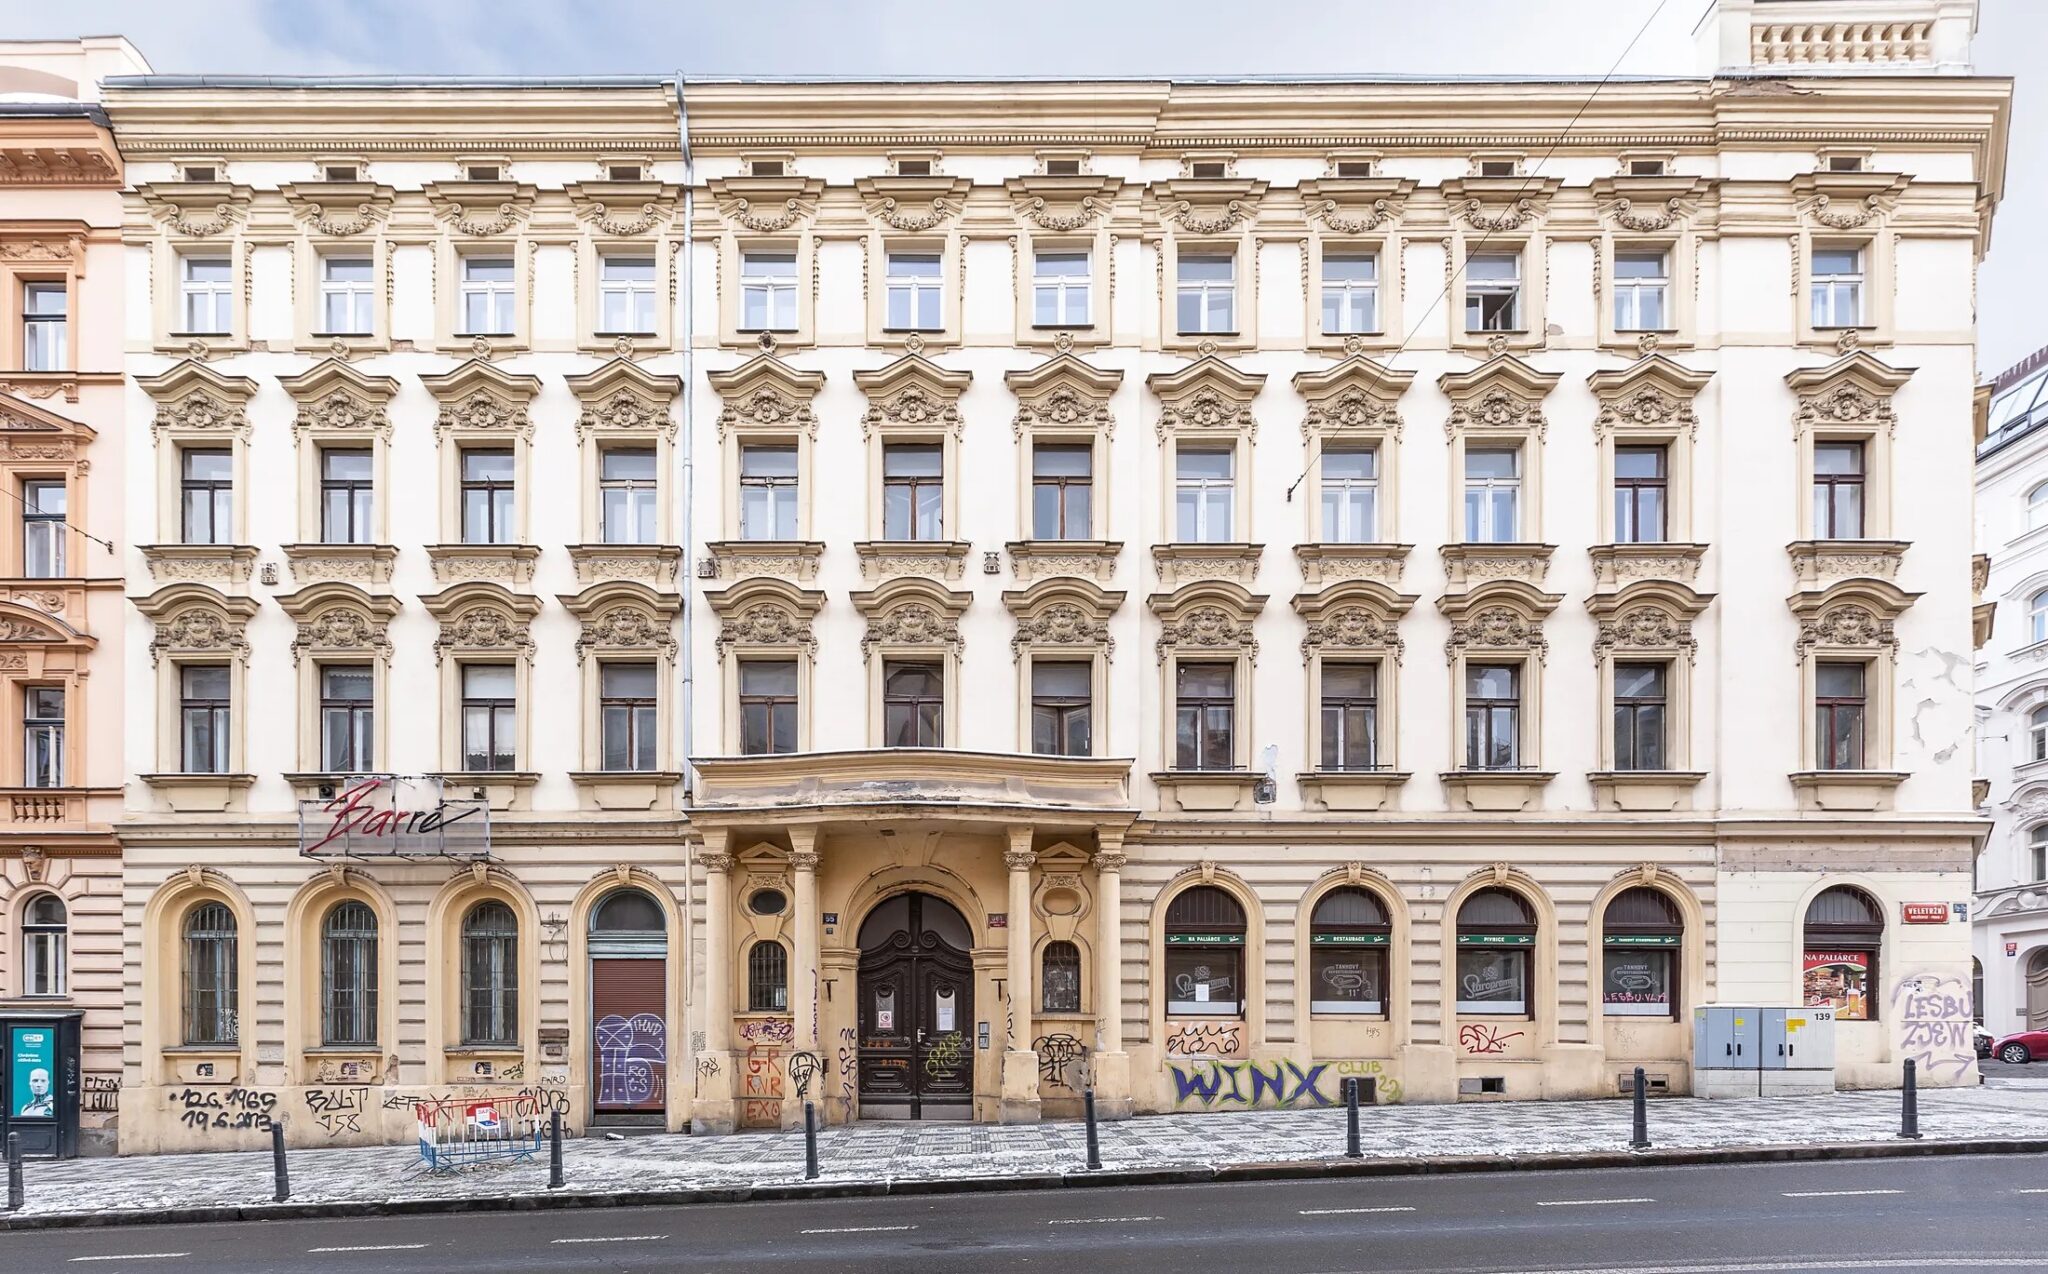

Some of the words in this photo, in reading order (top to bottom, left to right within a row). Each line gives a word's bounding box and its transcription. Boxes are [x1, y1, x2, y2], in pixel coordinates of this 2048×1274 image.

[1907, 904, 1945, 915] VELETRŽNÍ
[1804, 953, 1817, 961] NA
[1819, 952, 1859, 962] PALIÁRCE
[1904, 990, 1973, 1019] LESBU
[1814, 1012, 1831, 1021] 139
[1337, 1060, 1383, 1075] CLUB
[1165, 1058, 1336, 1107] WINX
